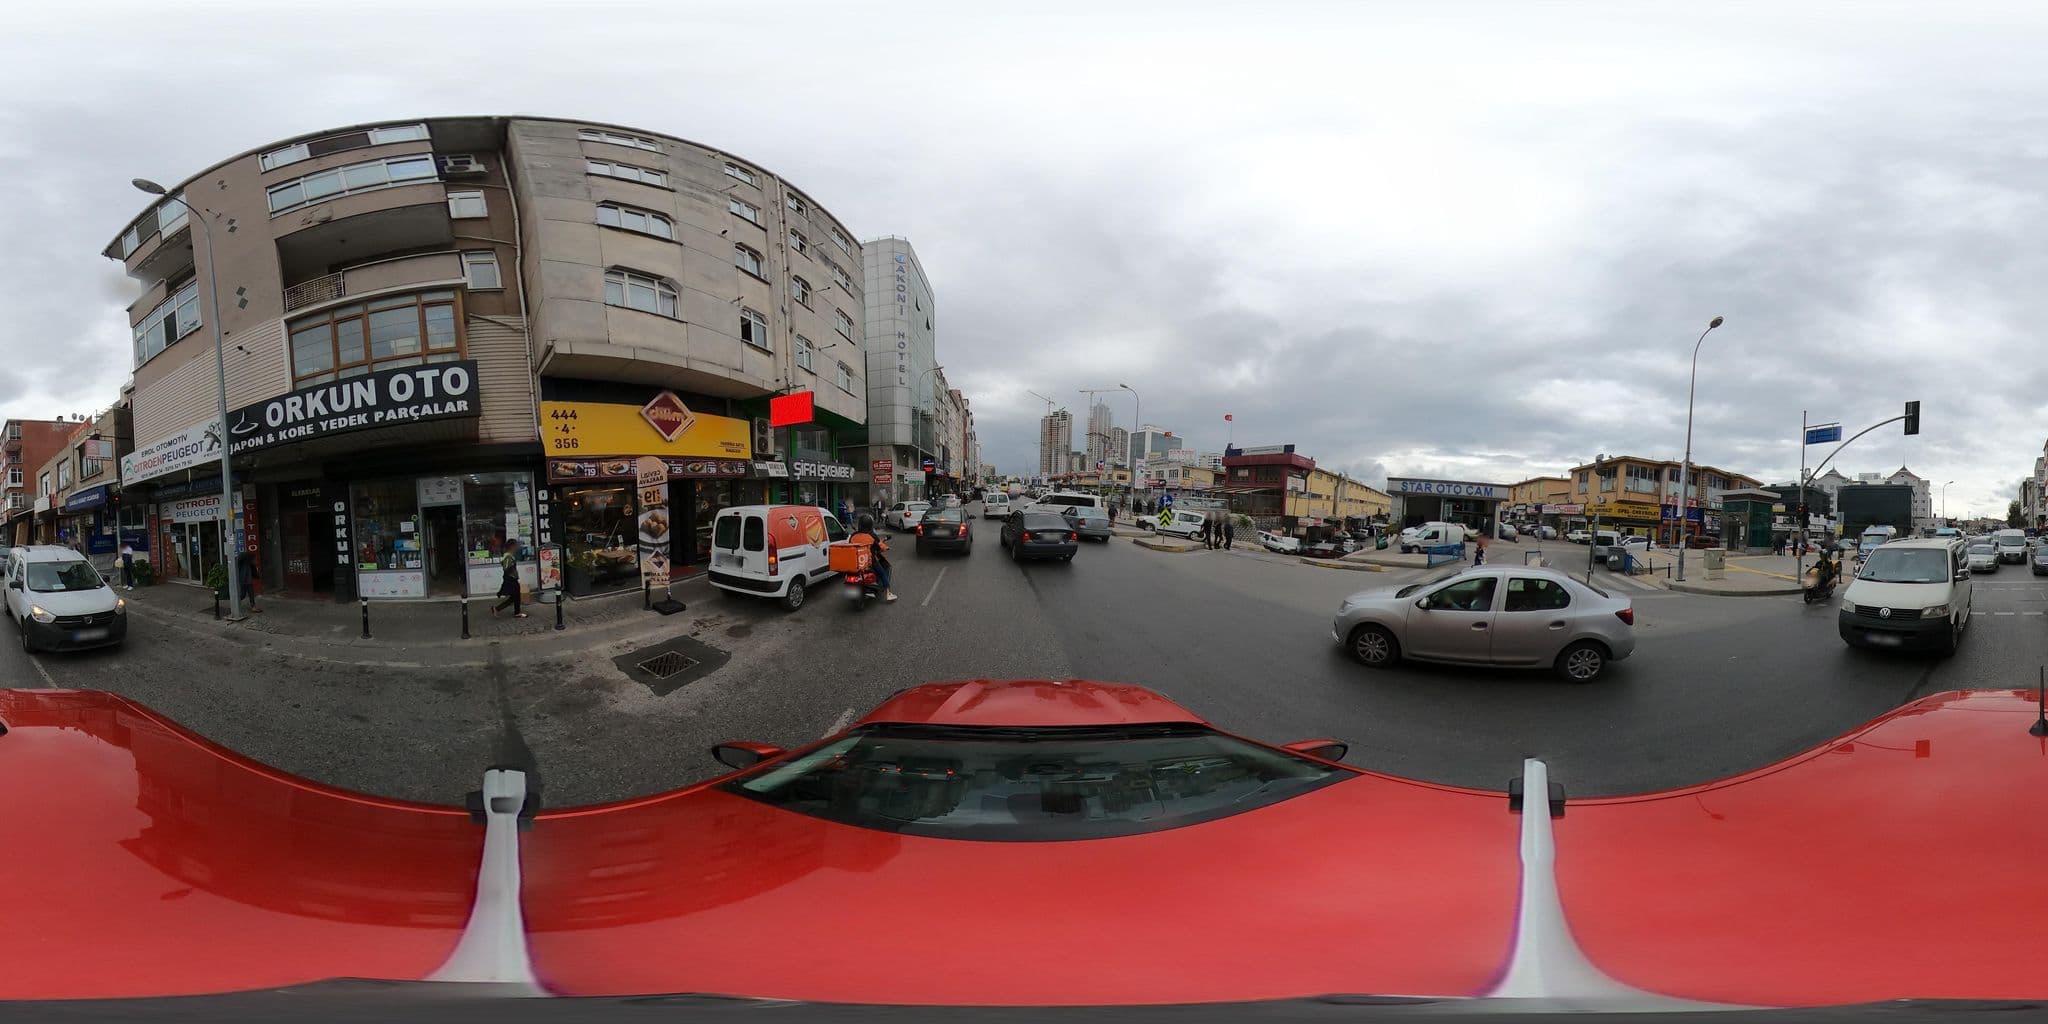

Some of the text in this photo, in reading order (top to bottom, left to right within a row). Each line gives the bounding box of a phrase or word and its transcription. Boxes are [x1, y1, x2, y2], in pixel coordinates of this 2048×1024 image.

[897, 331, 906, 386] HOTEL
[266, 367, 470, 427] ORKUN OTO
[551, 409, 577, 420] 444
[230, 400, 469, 455] JAPON & KORE YEDEK PARÇALAR
[554, 438, 579, 449] 356
[793, 459, 816, 480] ŞİFA
[1401, 481, 1493, 497] STAR OTO CAM
[176, 508, 220, 518] PEUGEOT
[538, 489, 551, 543] ORKU
[334, 501, 349, 564] ORKUN
